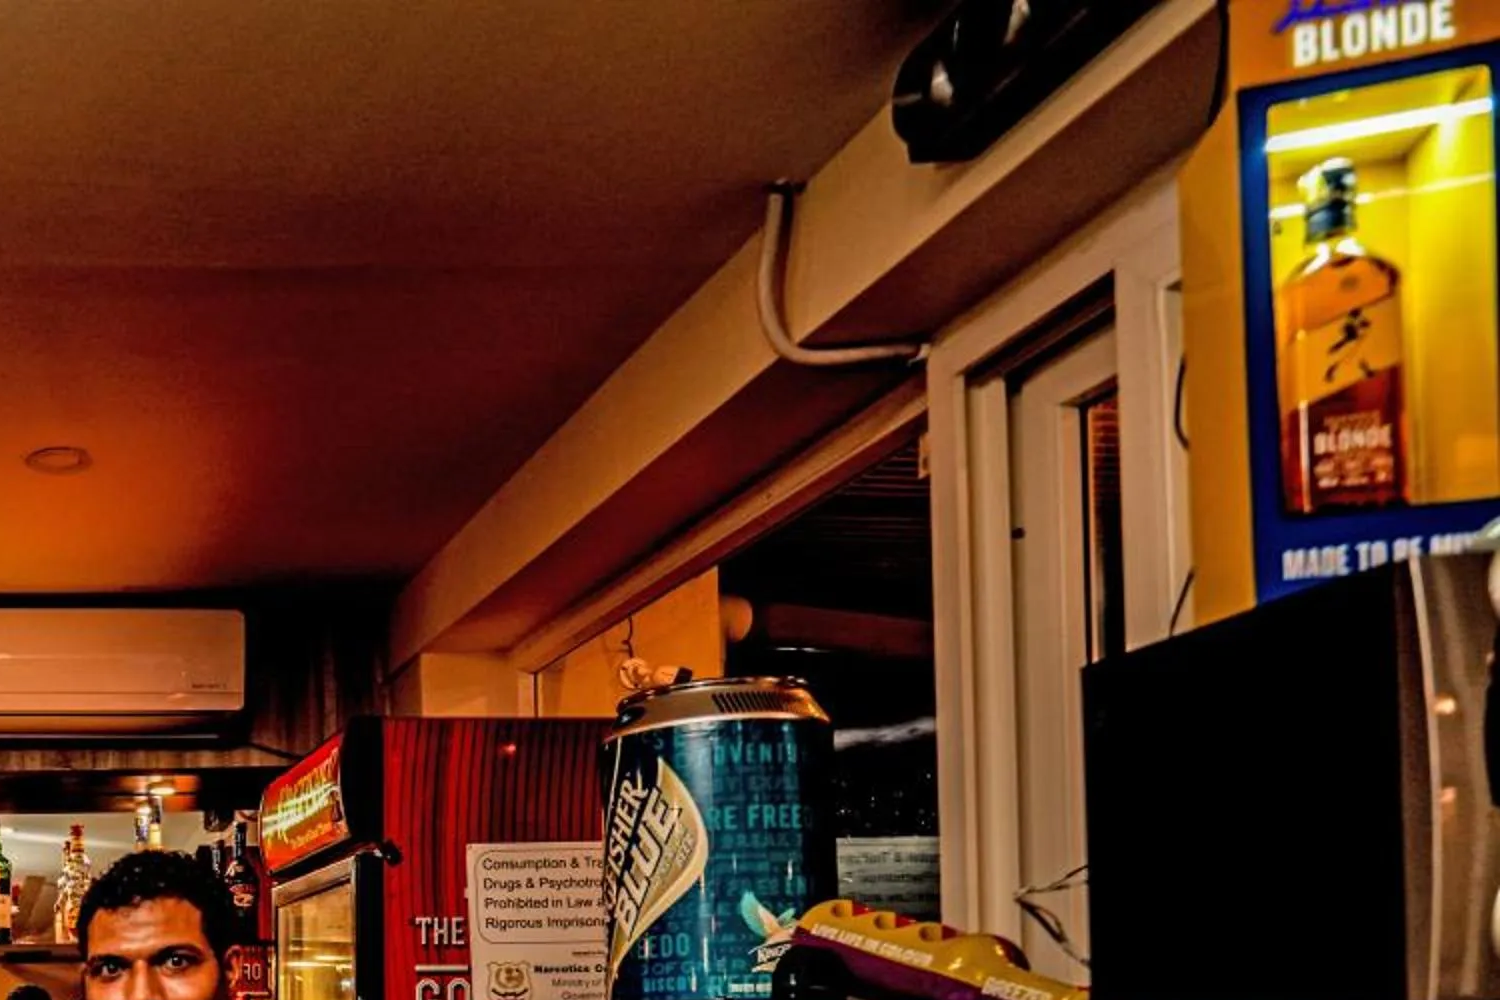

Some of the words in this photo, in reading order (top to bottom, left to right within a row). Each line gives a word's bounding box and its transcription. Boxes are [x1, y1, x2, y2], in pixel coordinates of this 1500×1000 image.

[1293, 0, 1456, 68] BLONDE
[1282, 543, 1351, 581] MADE
[1355, 540, 1388, 572] TO
[482, 857, 567, 872] Consumption
[570, 858, 580, 868] &
[585, 856, 604, 868] Tra
[614, 785, 683, 938] BLUE
[483, 878, 521, 892] Drugs
[525, 878, 535, 889] &
[539, 877, 605, 891] Psychotro
[484, 898, 549, 910] Prohibited
[552, 898, 563, 909] in
[567, 897, 593, 908] Law
[415, 917, 465, 945] THE
[485, 917, 543, 931] Rigorous
[547, 917, 606, 930] Imprison
[533, 963, 590, 974] Narcotics
[561, 991, 607, 1000] Govern
